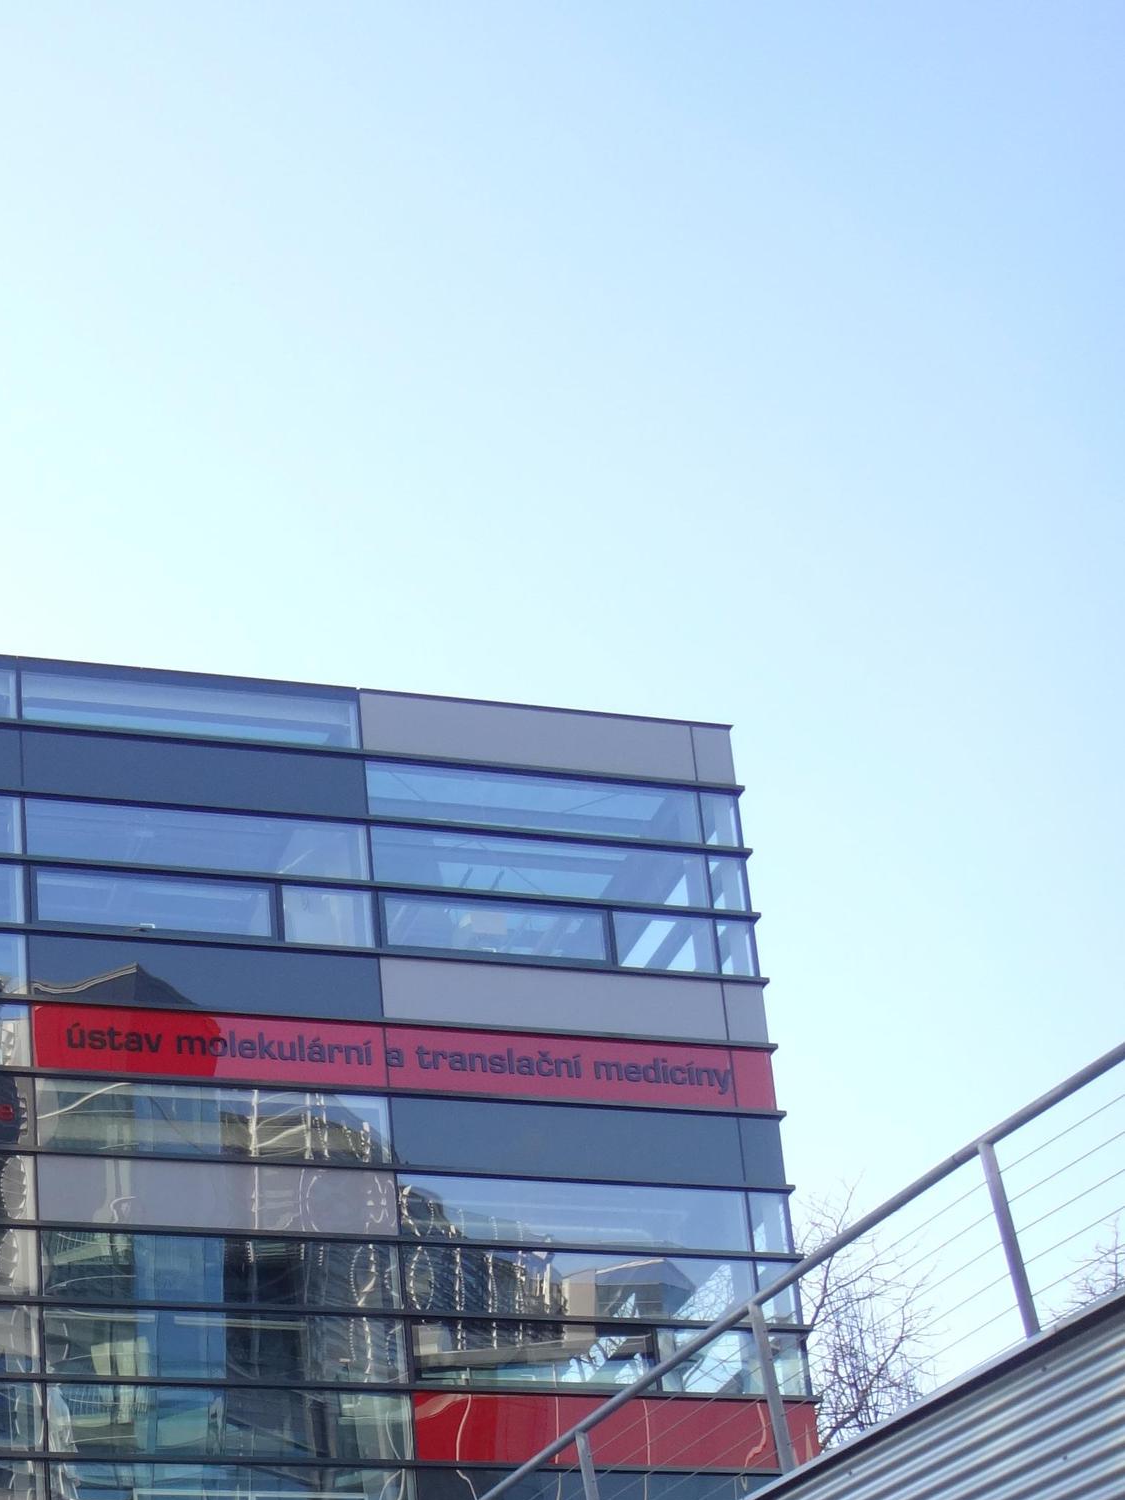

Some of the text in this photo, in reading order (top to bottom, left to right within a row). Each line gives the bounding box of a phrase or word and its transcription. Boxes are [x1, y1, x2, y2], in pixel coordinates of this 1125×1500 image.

[67, 1020, 732, 1095] ústav molekulární a translační medicíny
